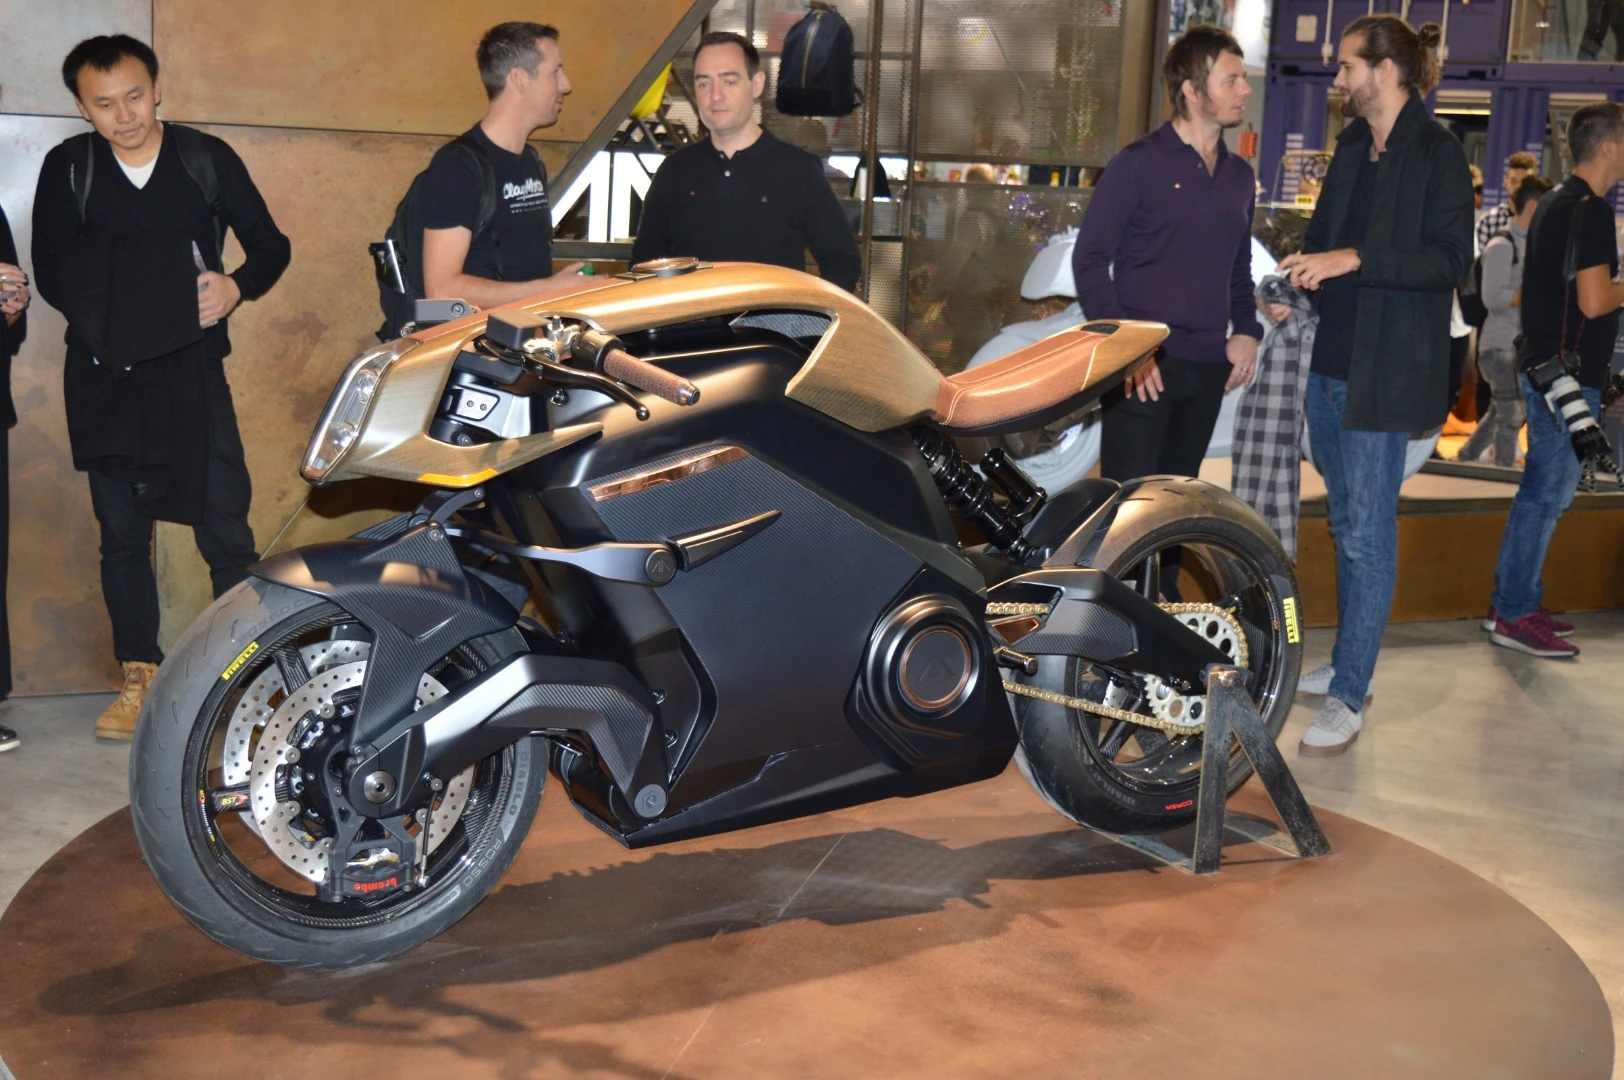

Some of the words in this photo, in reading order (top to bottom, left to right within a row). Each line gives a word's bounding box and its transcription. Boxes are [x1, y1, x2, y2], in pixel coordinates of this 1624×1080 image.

[1283, 597, 1299, 643] PIRELLI
[221, 641, 259, 680] PIRELLI
[221, 796, 237, 805] BST
[508, 751, 530, 815] DIABLO
[1165, 799, 1193, 810] CORSA
[463, 838, 502, 887] ROSSO
[353, 877, 397, 893] brembo
